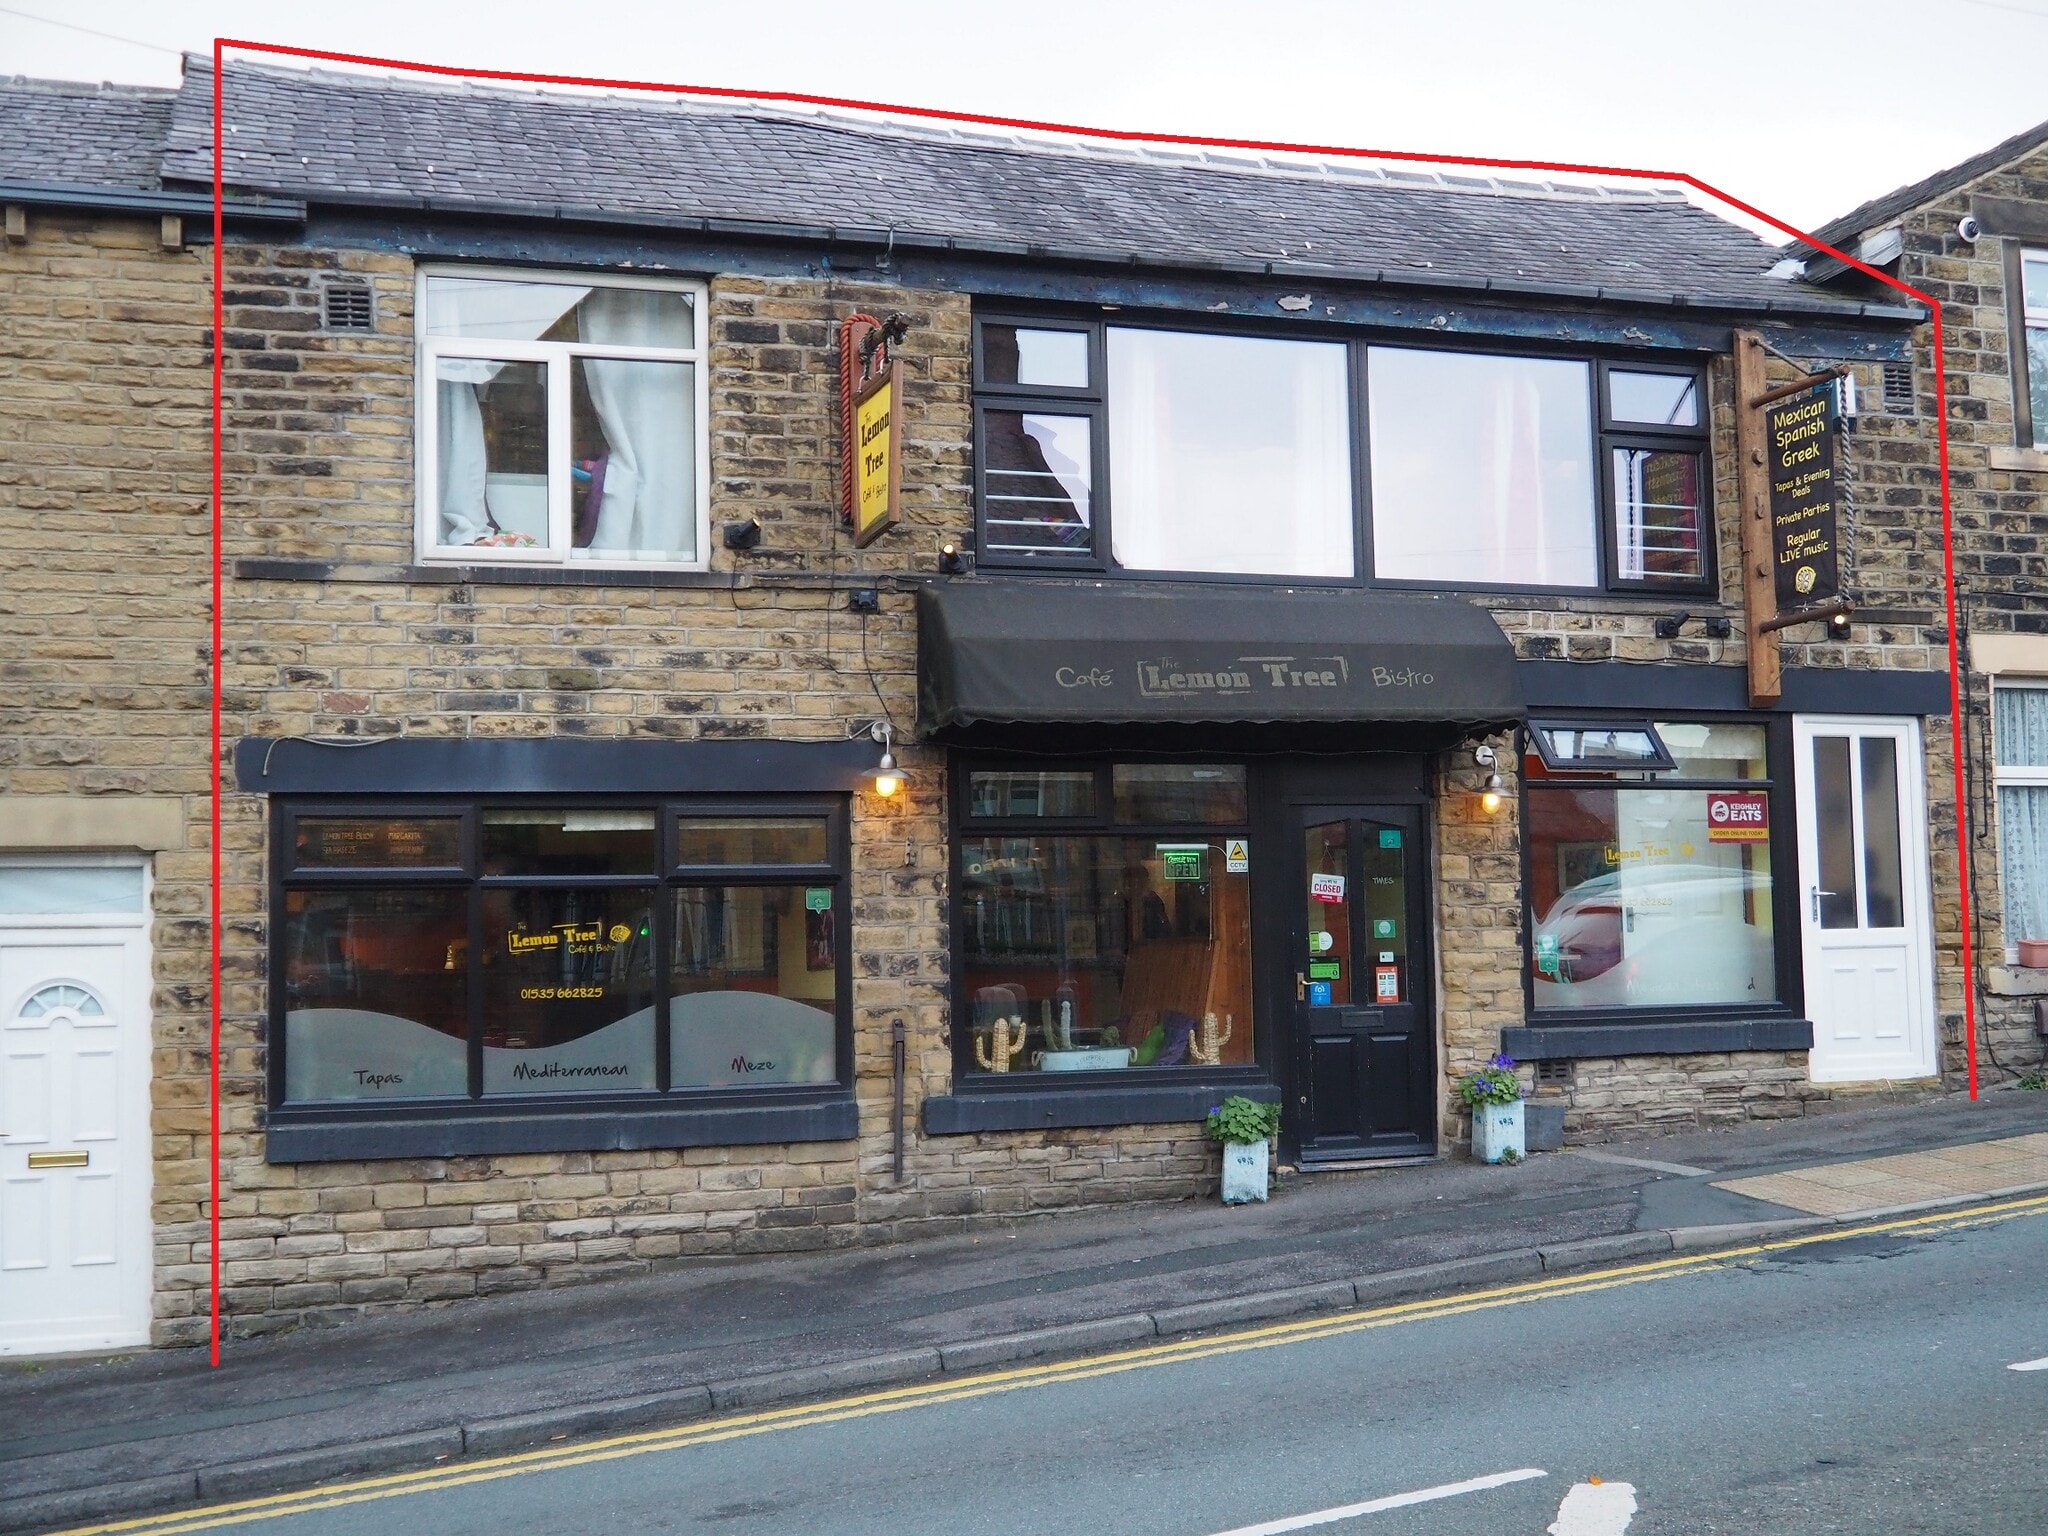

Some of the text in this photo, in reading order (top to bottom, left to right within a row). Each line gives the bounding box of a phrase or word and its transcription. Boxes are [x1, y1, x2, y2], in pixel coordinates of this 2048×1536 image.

[1774, 401, 1825, 430] Mexican
[861, 412, 889, 448] Lemon
[1776, 417, 1825, 449] Spanish
[865, 451, 883, 477] Tree
[1782, 441, 1820, 468] Greek
[1775, 468, 1830, 492] Tapas & Evening
[1792, 485, 1811, 498] Deals
[1776, 502, 1830, 526] Private Parties
[1787, 528, 1821, 547] Regular
[1780, 540, 1829, 563] LIVE music
[1055, 663, 1435, 690] Café Lemon Tree Bistro
[1730, 803, 1761, 811] KEIGHLEY
[1730, 811, 1762, 822] EATS
[1607, 845, 1669, 861] Lemon Tree
[1314, 883, 1341, 894] CLOSED
[512, 929, 597, 947] Lemon Tree
[520, 987, 603, 1000] 01535 662825
[513, 1061, 629, 1081] Mediterranean
[731, 1055, 777, 1073] Meze
[353, 1069, 404, 1087] Tapas
